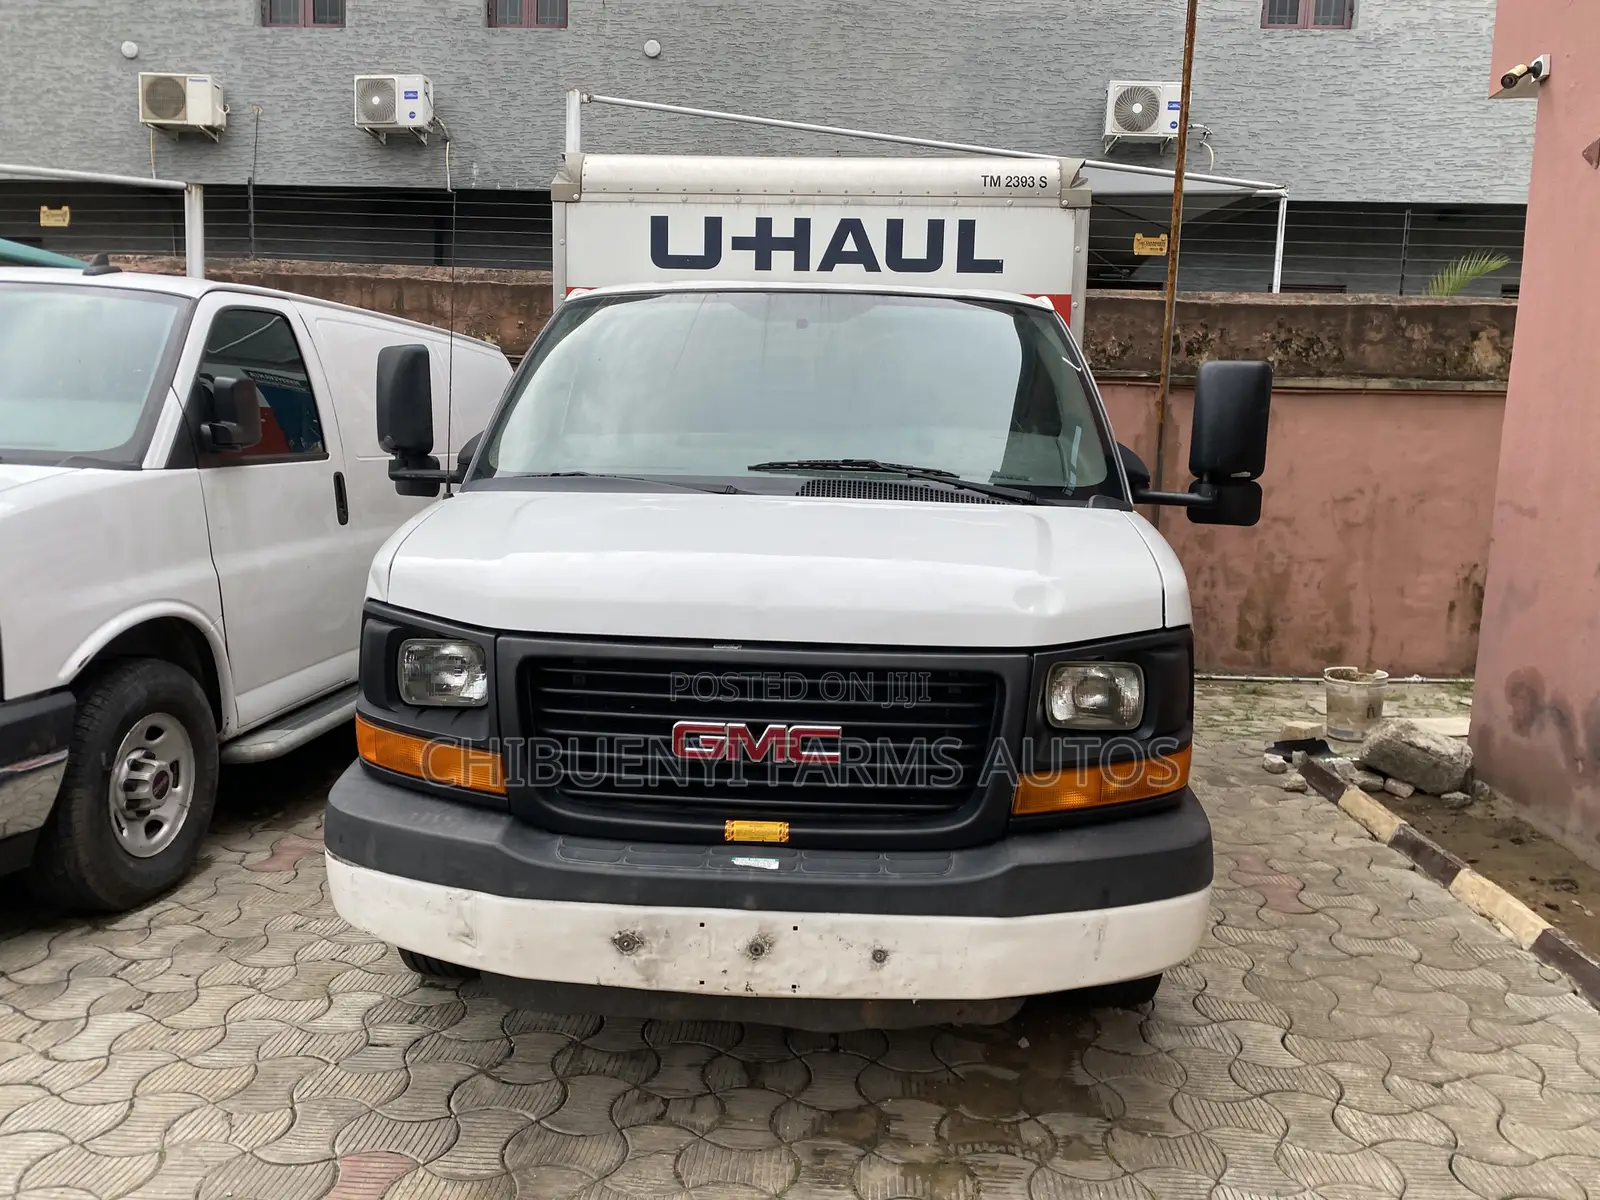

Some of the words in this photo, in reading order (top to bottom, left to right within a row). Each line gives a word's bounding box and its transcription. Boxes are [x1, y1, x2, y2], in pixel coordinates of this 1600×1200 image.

[981, 175, 1001, 188] TM
[1005, 175, 1036, 189] 2393
[1038, 175, 1049, 189] S
[650, 215, 1004, 274] U-HAUL
[672, 720, 843, 764] GMC
